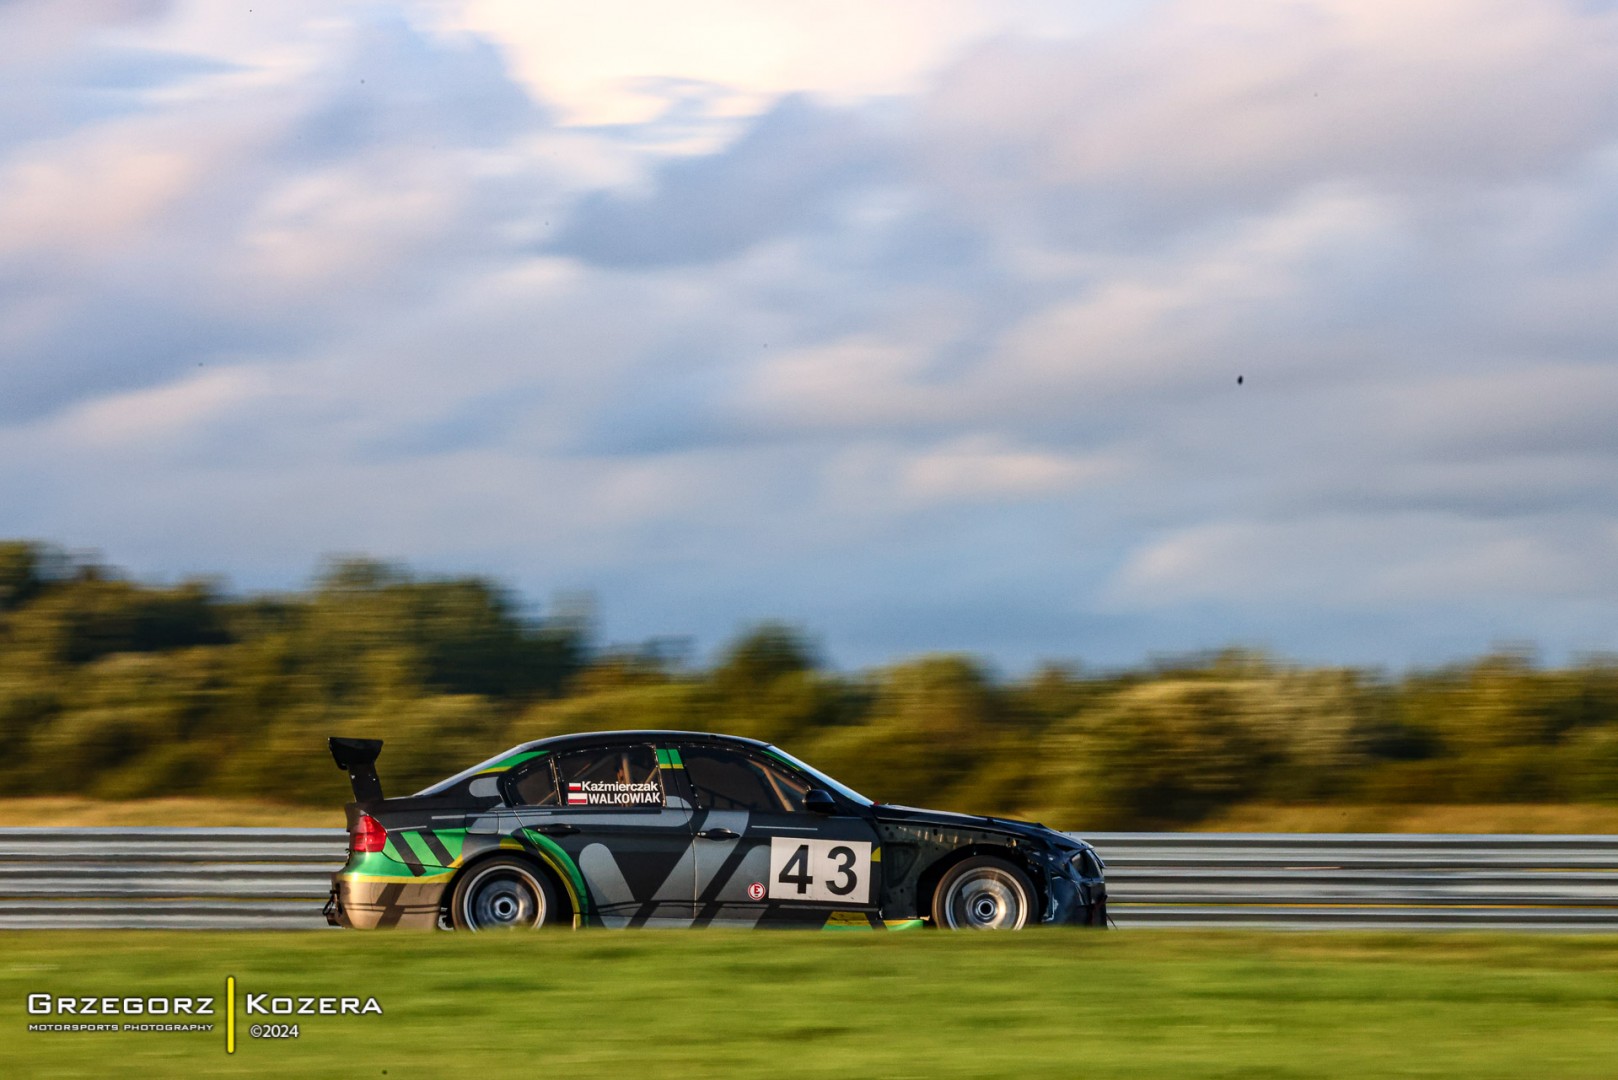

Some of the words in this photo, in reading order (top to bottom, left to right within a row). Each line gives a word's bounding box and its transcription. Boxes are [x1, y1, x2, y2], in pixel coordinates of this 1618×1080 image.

[582, 780, 658, 792] Kaźmierczak
[588, 792, 660, 804] WALKOWIAK
[778, 844, 858, 896] 43
[753, 885, 760, 894] E
